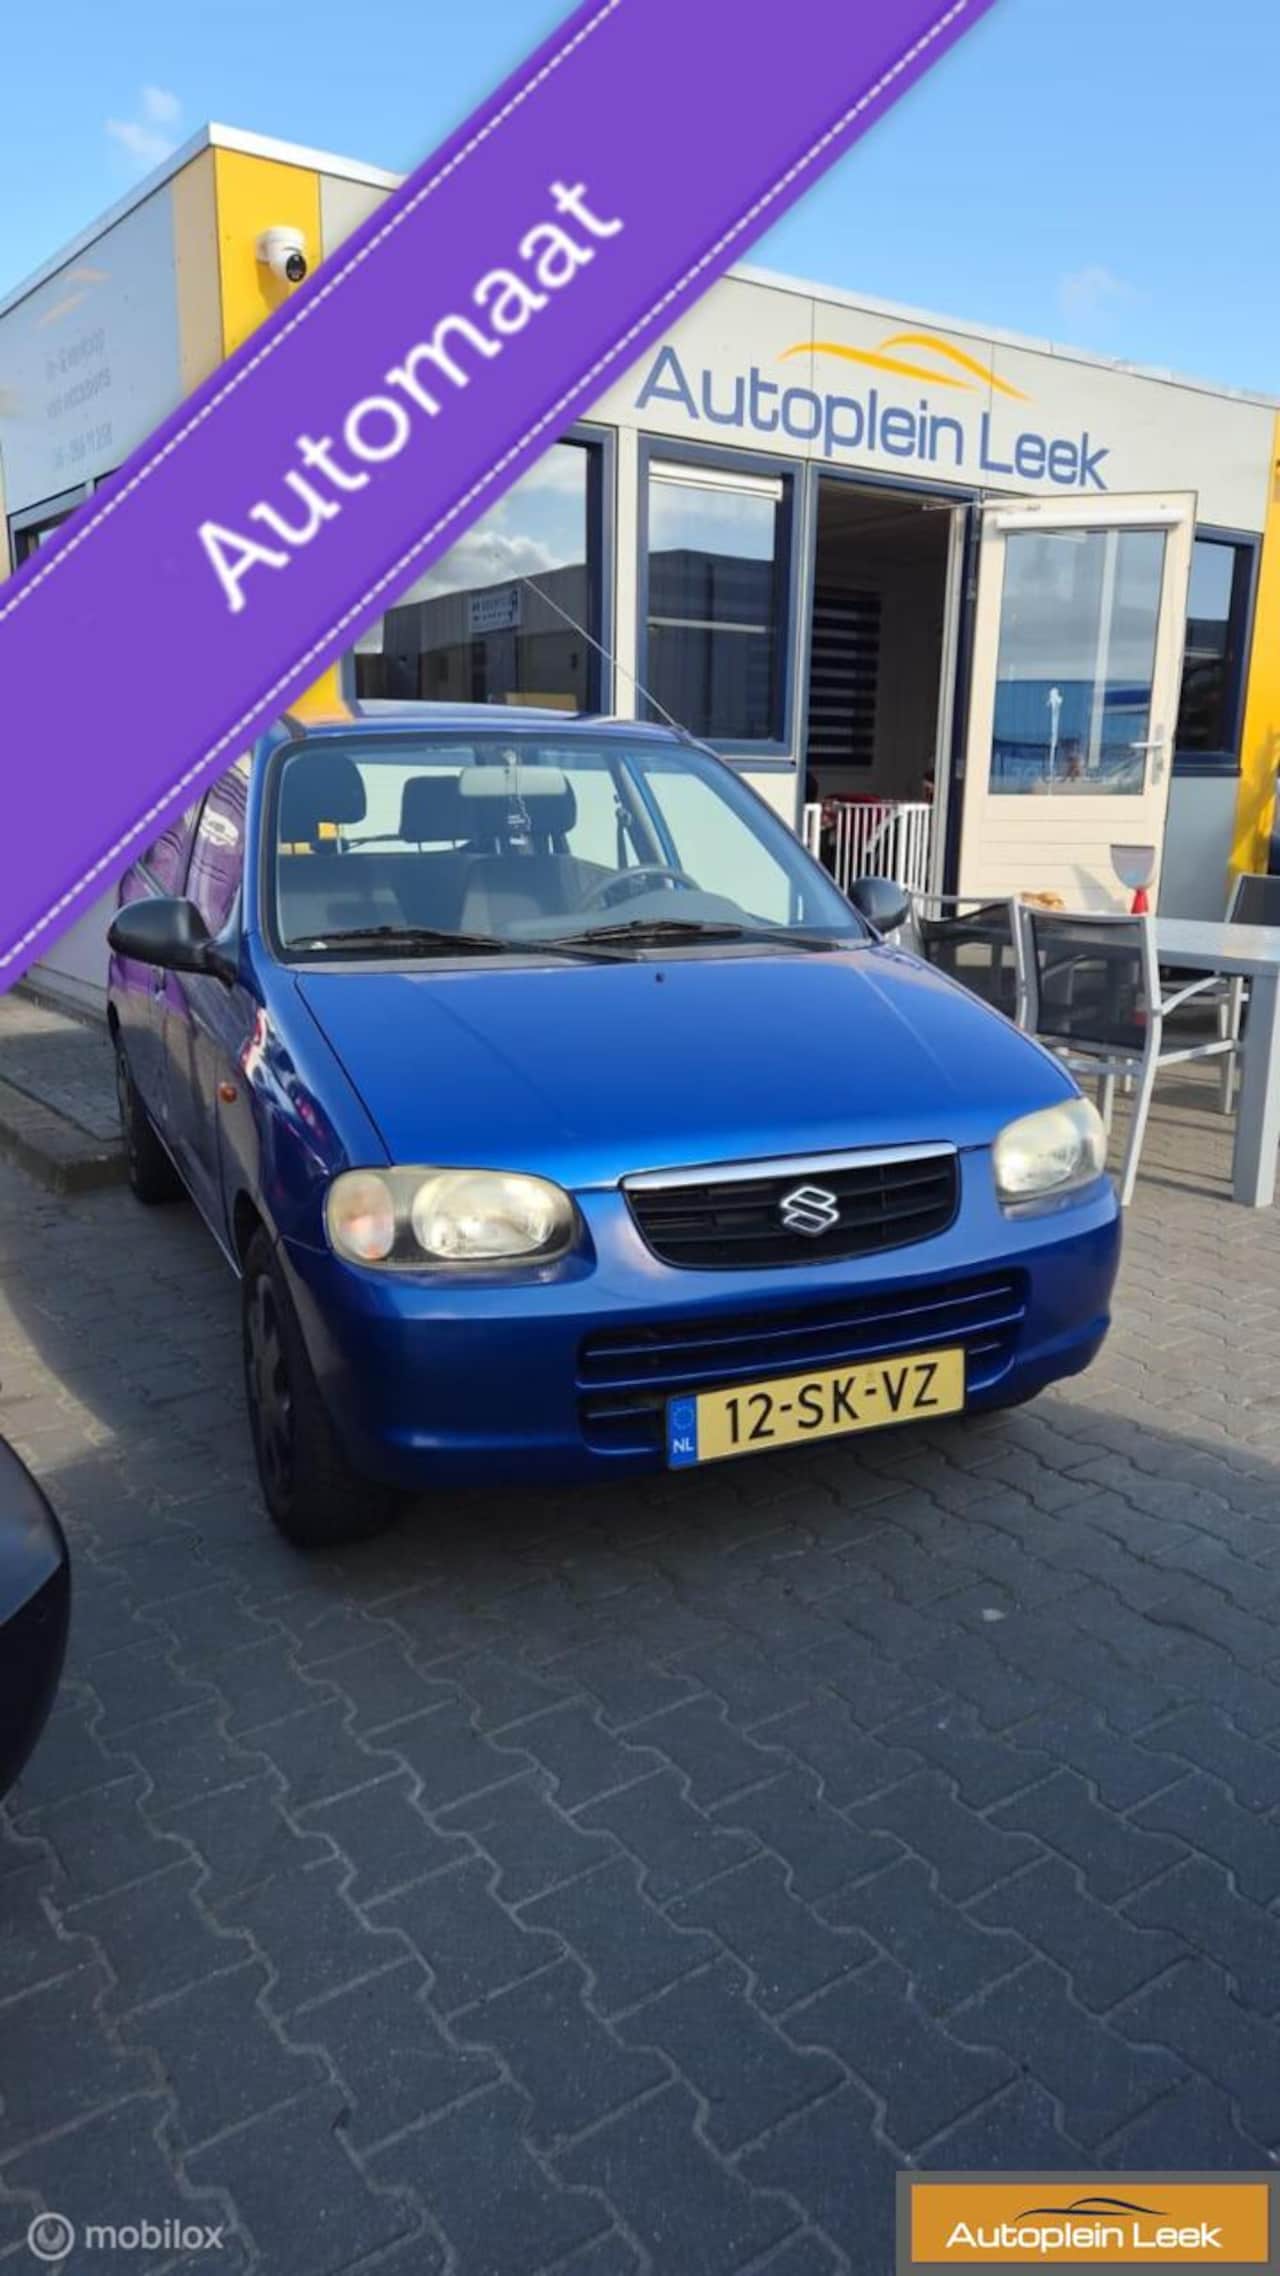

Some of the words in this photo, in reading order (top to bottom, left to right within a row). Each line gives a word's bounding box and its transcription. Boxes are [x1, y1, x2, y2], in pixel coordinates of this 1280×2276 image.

[634, 345, 964, 466] Autoplein
[979, 411, 1110, 490] Leek
[725, 1362, 938, 1444] 12-SK-VZ
[673, 1437, 694, 1453] NL
